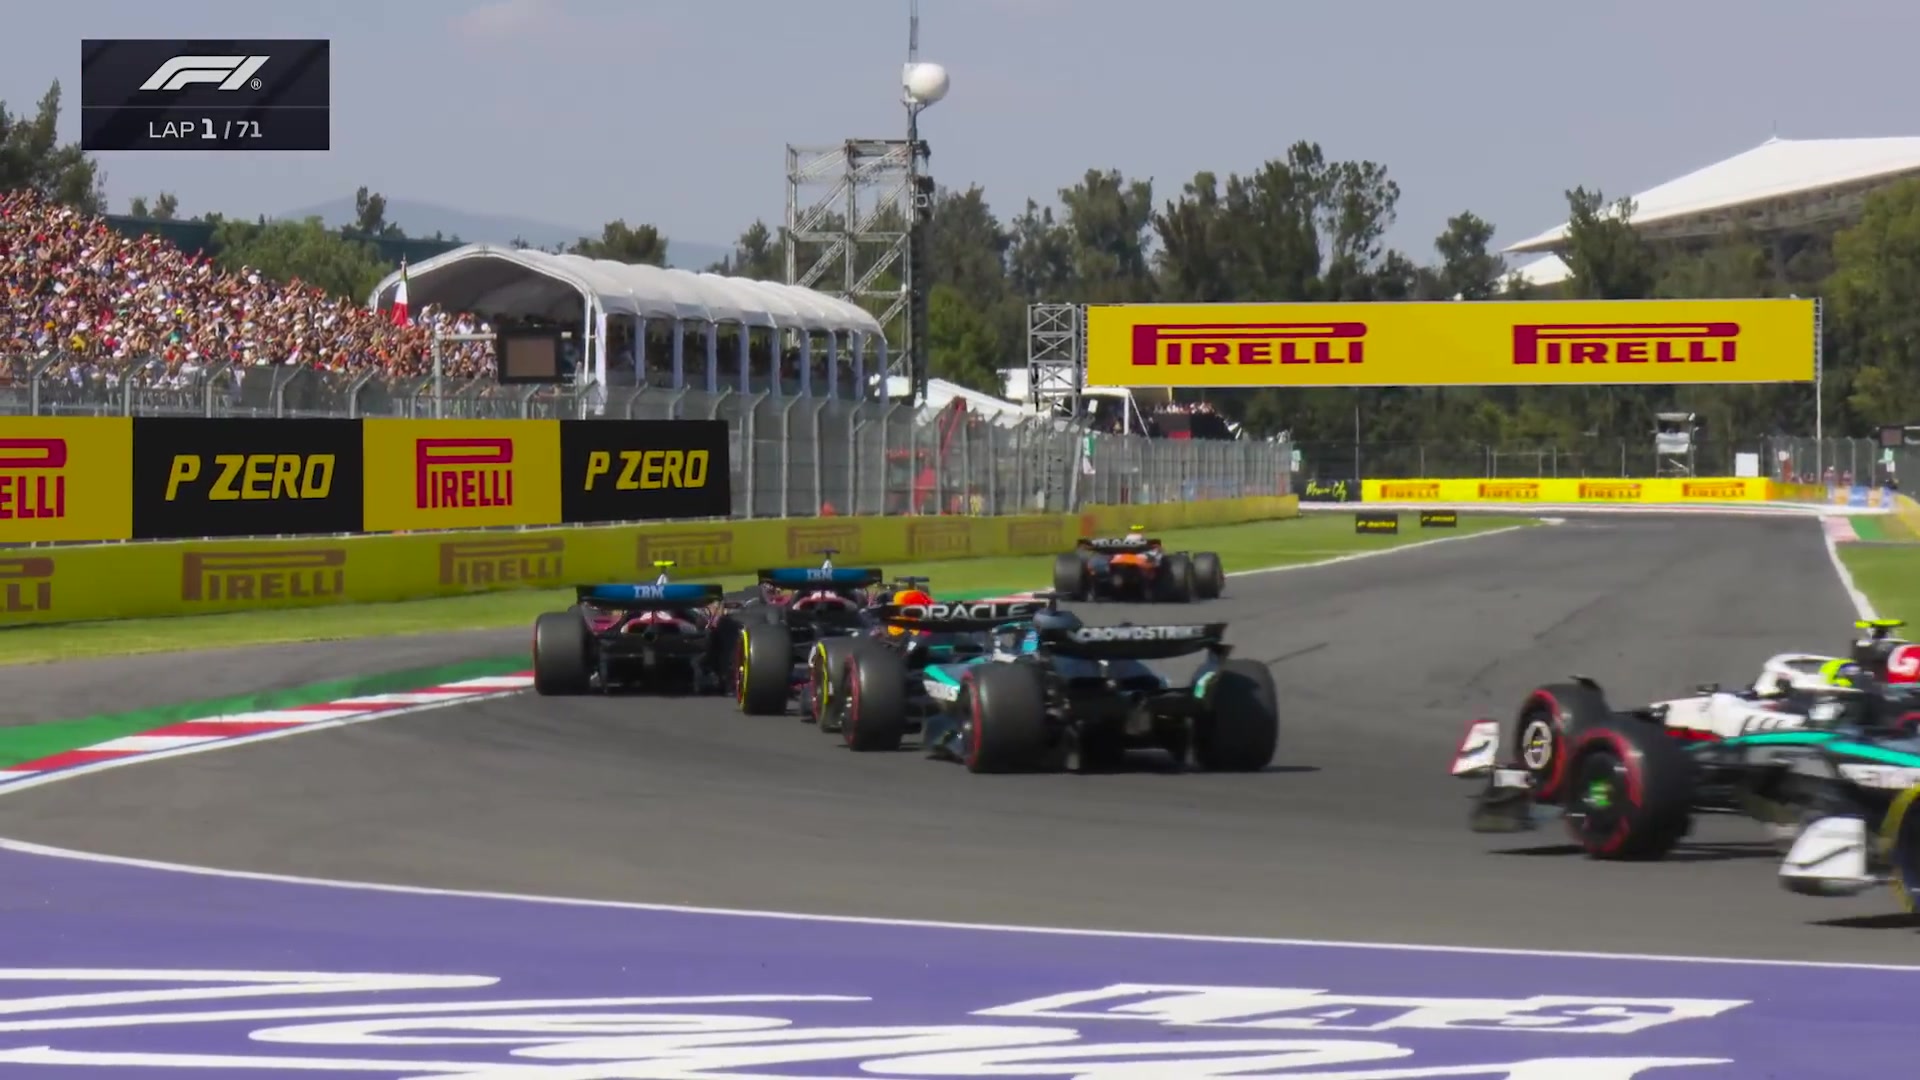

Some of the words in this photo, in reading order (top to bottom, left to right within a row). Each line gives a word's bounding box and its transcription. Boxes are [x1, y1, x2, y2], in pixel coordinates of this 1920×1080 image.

[1132, 322, 1368, 366] PIRELLI
[1512, 322, 1740, 365] PIRELLI
[165, 454, 201, 501] P
[208, 454, 336, 500] ZERO
[416, 438, 513, 508] PIRELLI
[584, 451, 610, 491] P
[616, 450, 709, 490] ZERO
[440, 538, 564, 585] PIRELLI
[637, 531, 733, 570] PIRELLI
[181, 550, 346, 601] PIRELLI
[633, 585, 665, 600] IBM
[901, 602, 1036, 624] ORACLE
[1076, 625, 1204, 643] CROWDSTRIKE
